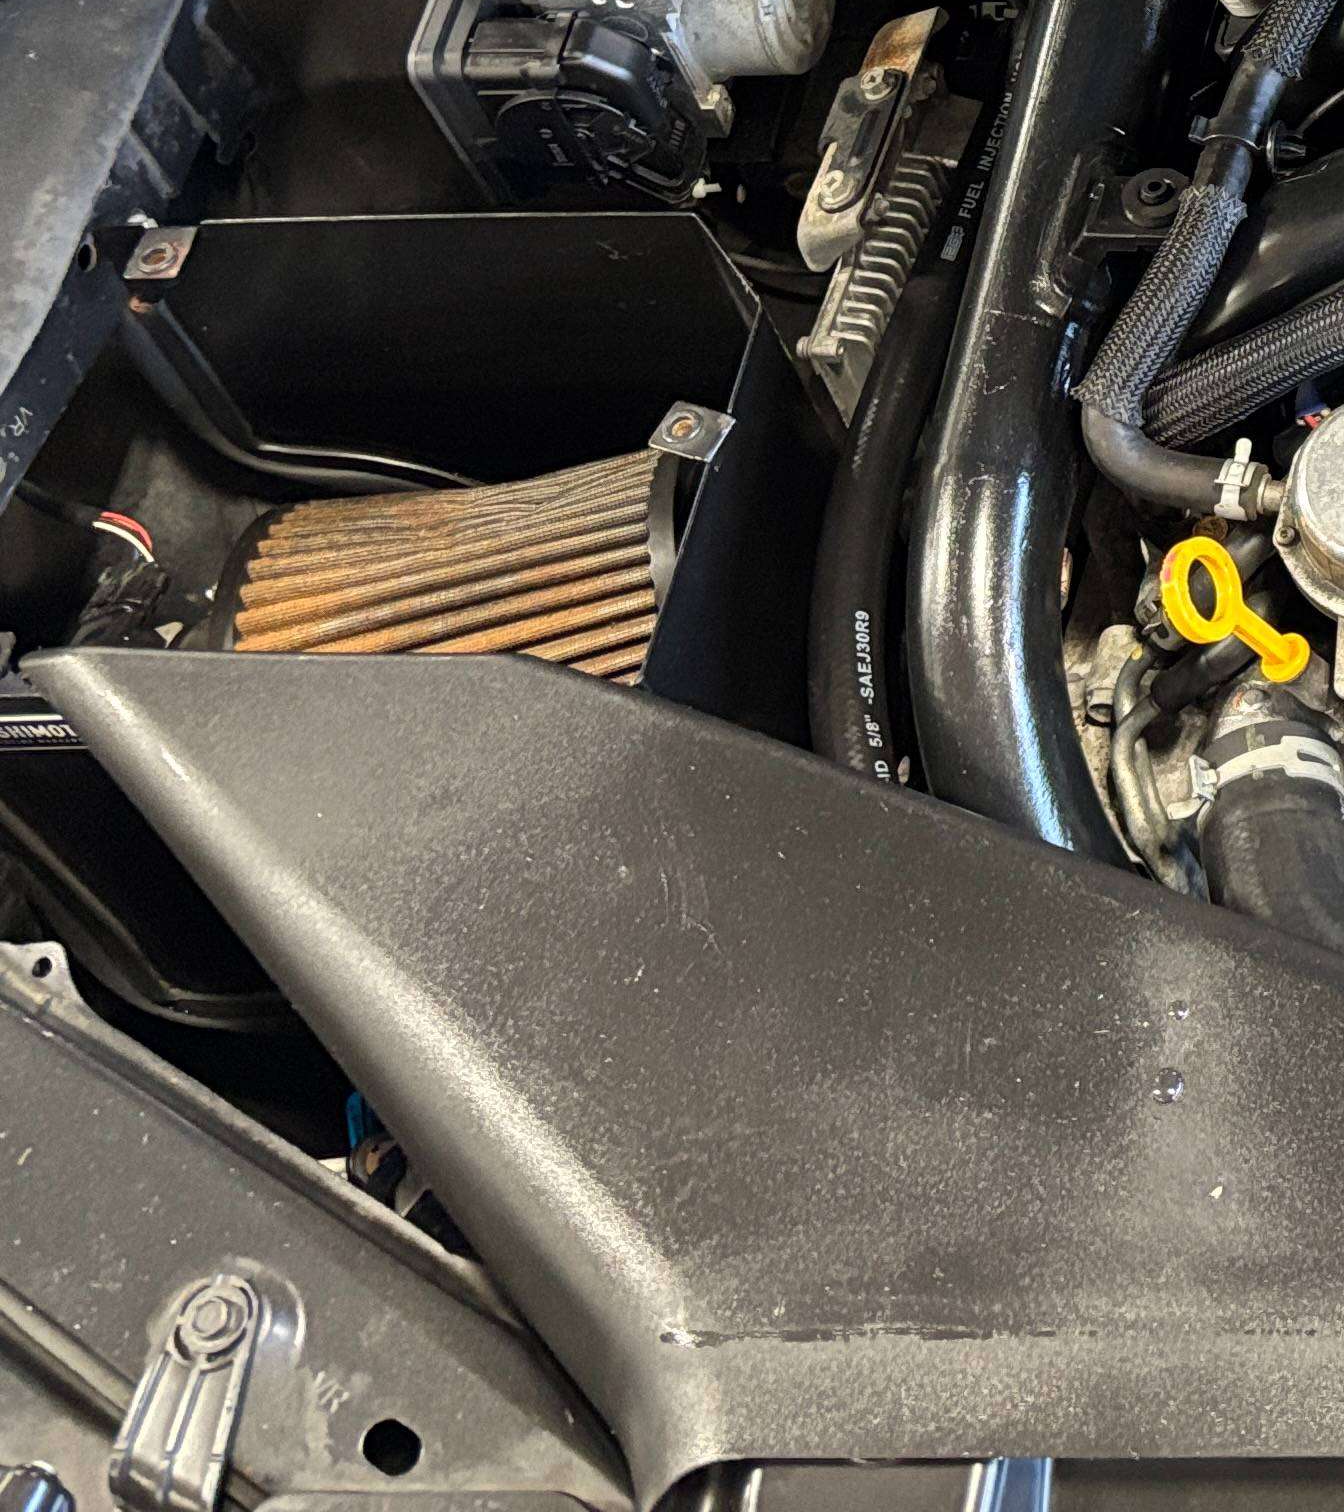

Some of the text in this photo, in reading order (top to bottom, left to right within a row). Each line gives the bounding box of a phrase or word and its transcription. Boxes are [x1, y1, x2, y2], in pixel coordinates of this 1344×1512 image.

[956, 177, 986, 220] FUEL
[848, 610, 880, 704] -SAEJ30R9
[0, 723, 80, 739] SHIMOT
